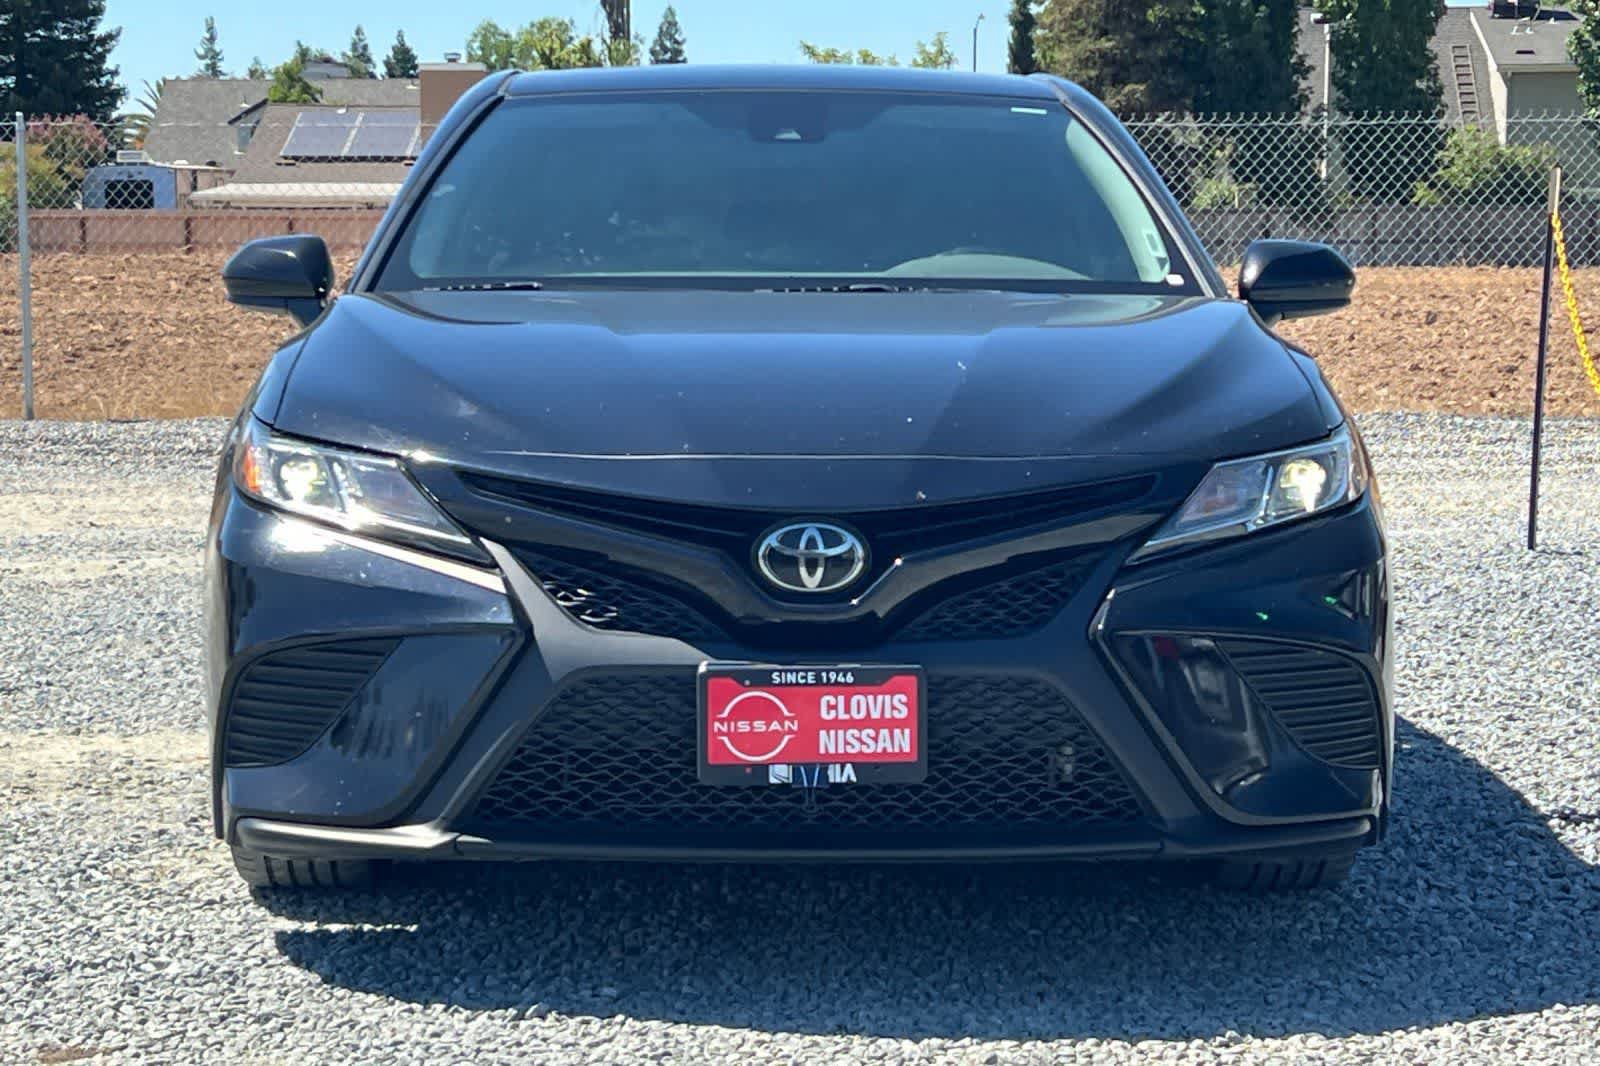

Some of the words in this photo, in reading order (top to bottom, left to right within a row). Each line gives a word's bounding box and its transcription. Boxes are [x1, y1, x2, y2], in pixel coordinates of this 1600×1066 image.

[771, 671, 817, 684] SINCE
[821, 671, 855, 684] 1946
[820, 693, 909, 721] CLOVIS
[713, 719, 799, 733] NISSAN
[818, 728, 911, 755] NISSAN
